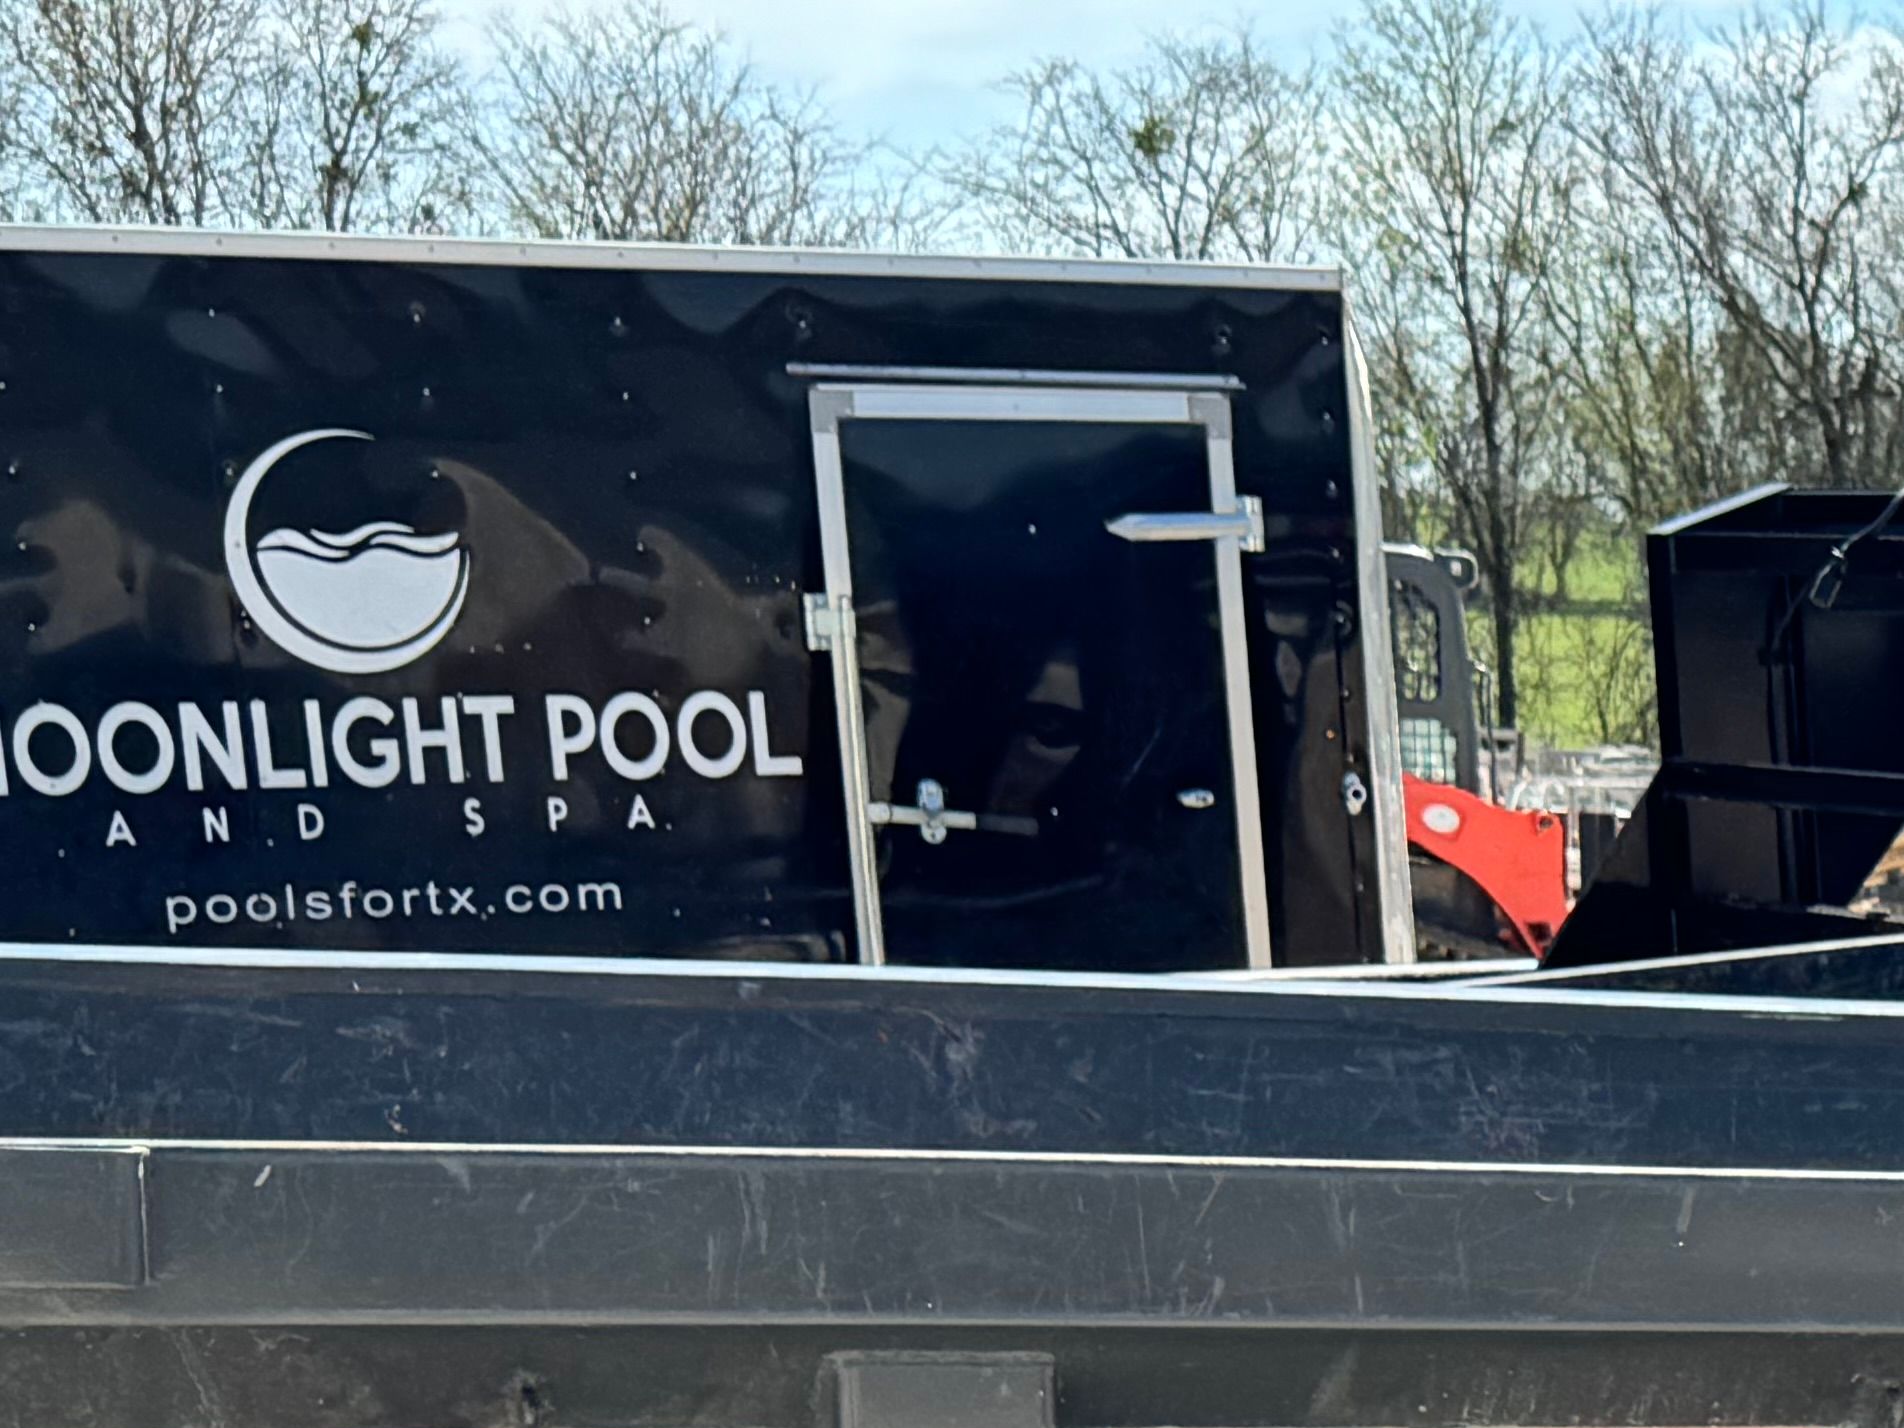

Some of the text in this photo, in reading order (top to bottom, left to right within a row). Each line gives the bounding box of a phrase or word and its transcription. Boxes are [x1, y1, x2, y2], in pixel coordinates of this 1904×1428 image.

[0, 688, 803, 797] OONLIGHT POOL
[165, 881, 623, 935] poolsfortx.com
